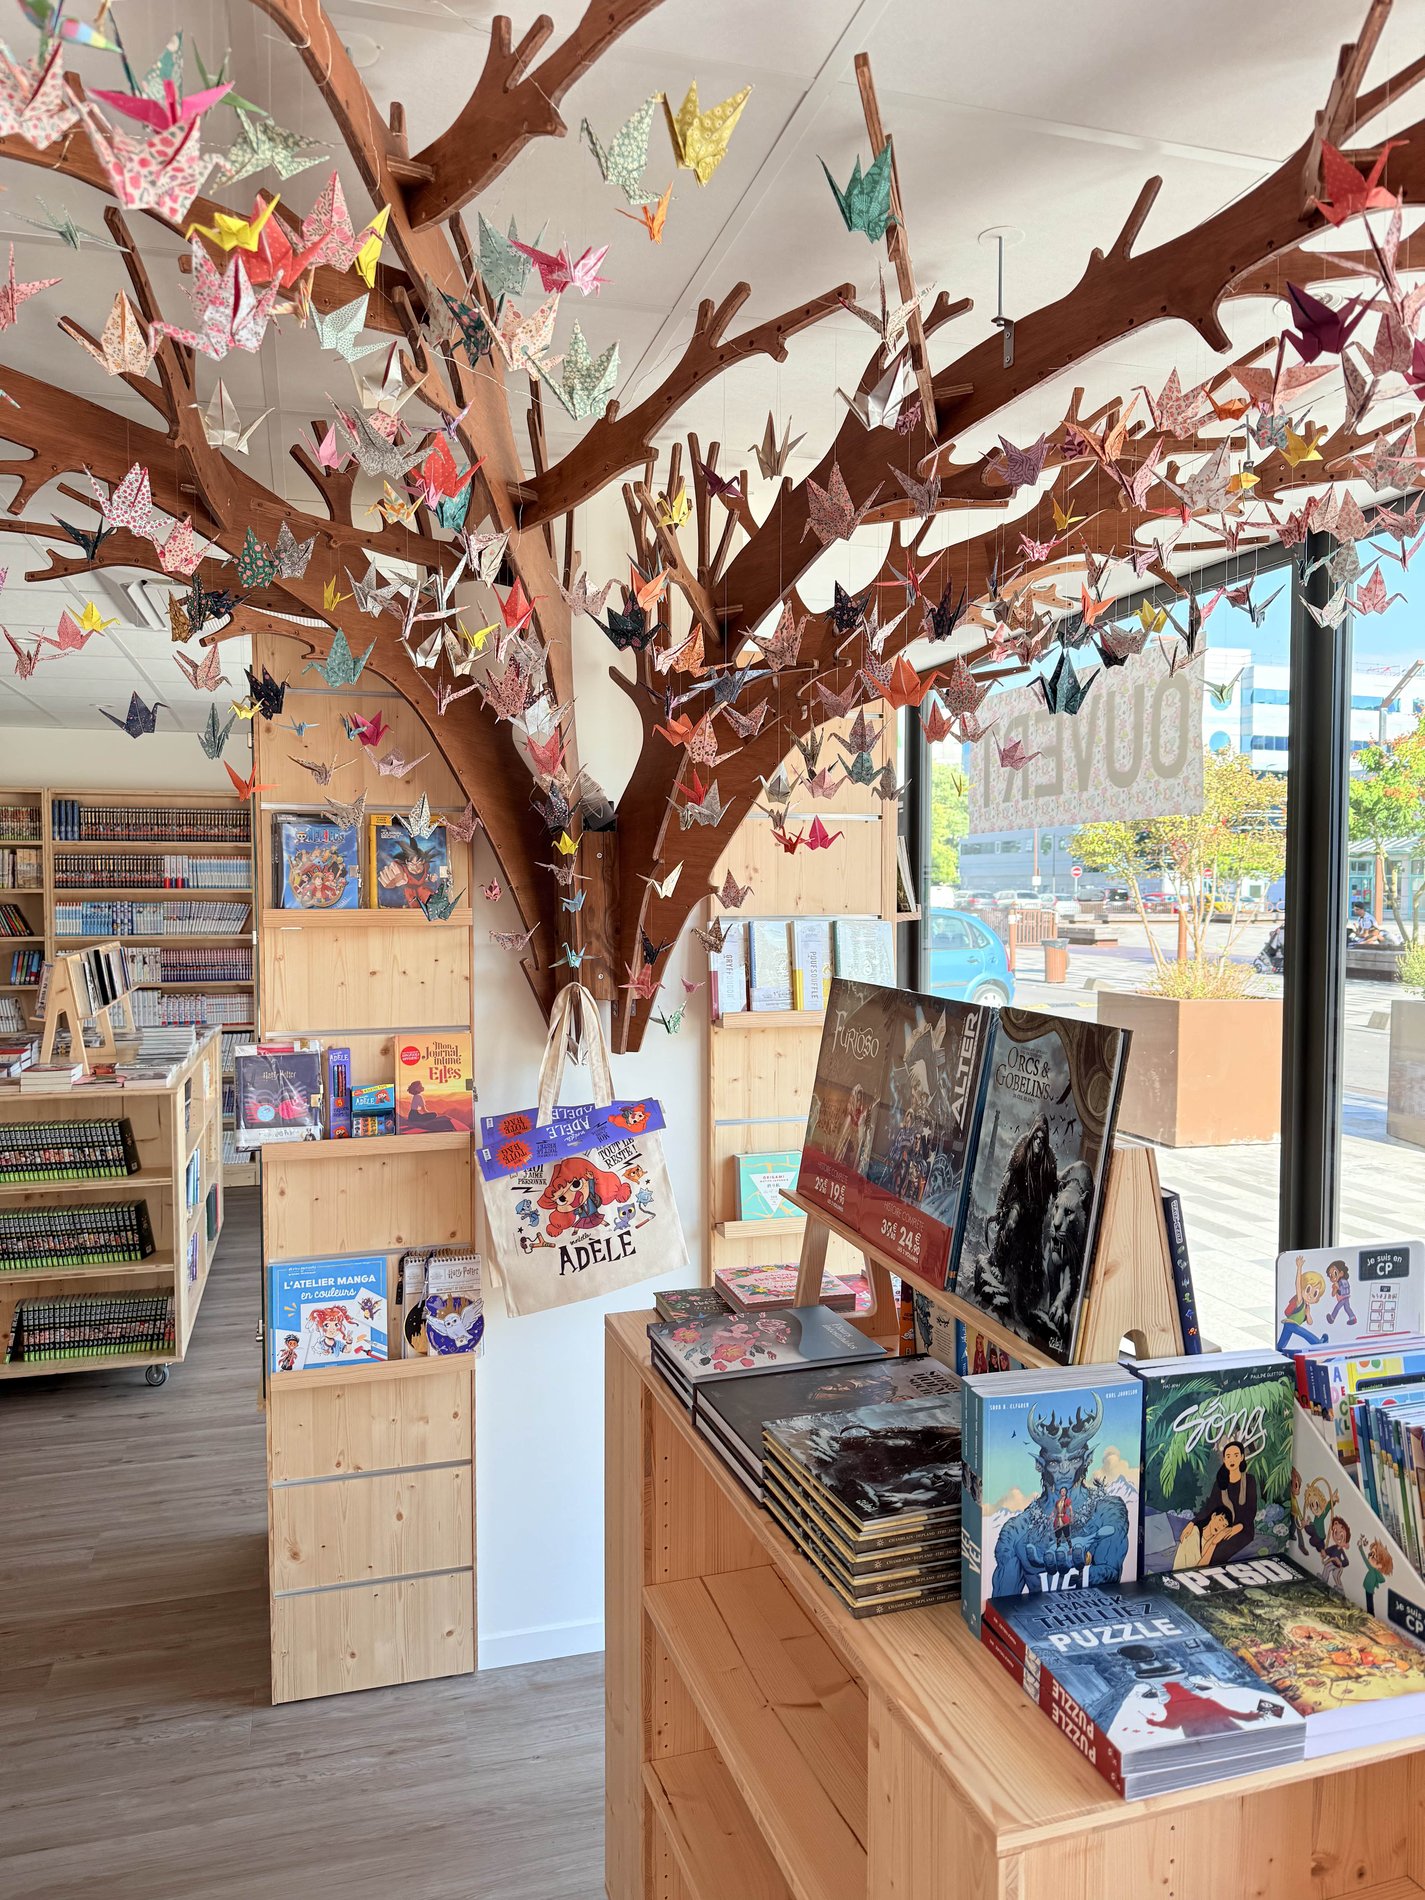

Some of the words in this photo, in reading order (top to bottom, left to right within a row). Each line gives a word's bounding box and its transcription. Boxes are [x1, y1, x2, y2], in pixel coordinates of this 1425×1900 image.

[952, 1012, 979, 1124] ALTER
[1008, 1046, 1040, 1076] ORCS
[1041, 1061, 1051, 1080] &
[429, 1065, 462, 1084] Elles
[996, 1063, 1054, 1102] GOBELINS
[597, 1141, 621, 1160] TOUT
[604, 1147, 633, 1169] RESTE
[558, 1230, 637, 1276] ADÈLE
[1377, 1253, 1392, 1262] suis
[1393, 1255, 1403, 1263] en
[1376, 1262, 1393, 1276] CP
[284, 1278, 334, 1290] L'ATELIER
[337, 1274, 376, 1285] MANGA
[301, 1291, 313, 1300] en
[314, 1287, 356, 1298] couleurs
[969, 1540, 981, 1575] VEI
[1043, 1595, 1128, 1614] FRANCK
[1058, 1590, 1091, 1600] MIG
[1033, 1602, 1161, 1629] THILLIEZ
[1406, 1614, 1424, 1634] CP
[1048, 1618, 1183, 1652] PUZZLE
[1051, 1678, 1095, 1741] PUZZLE
[1051, 1702, 1097, 1765] PUZZLE
